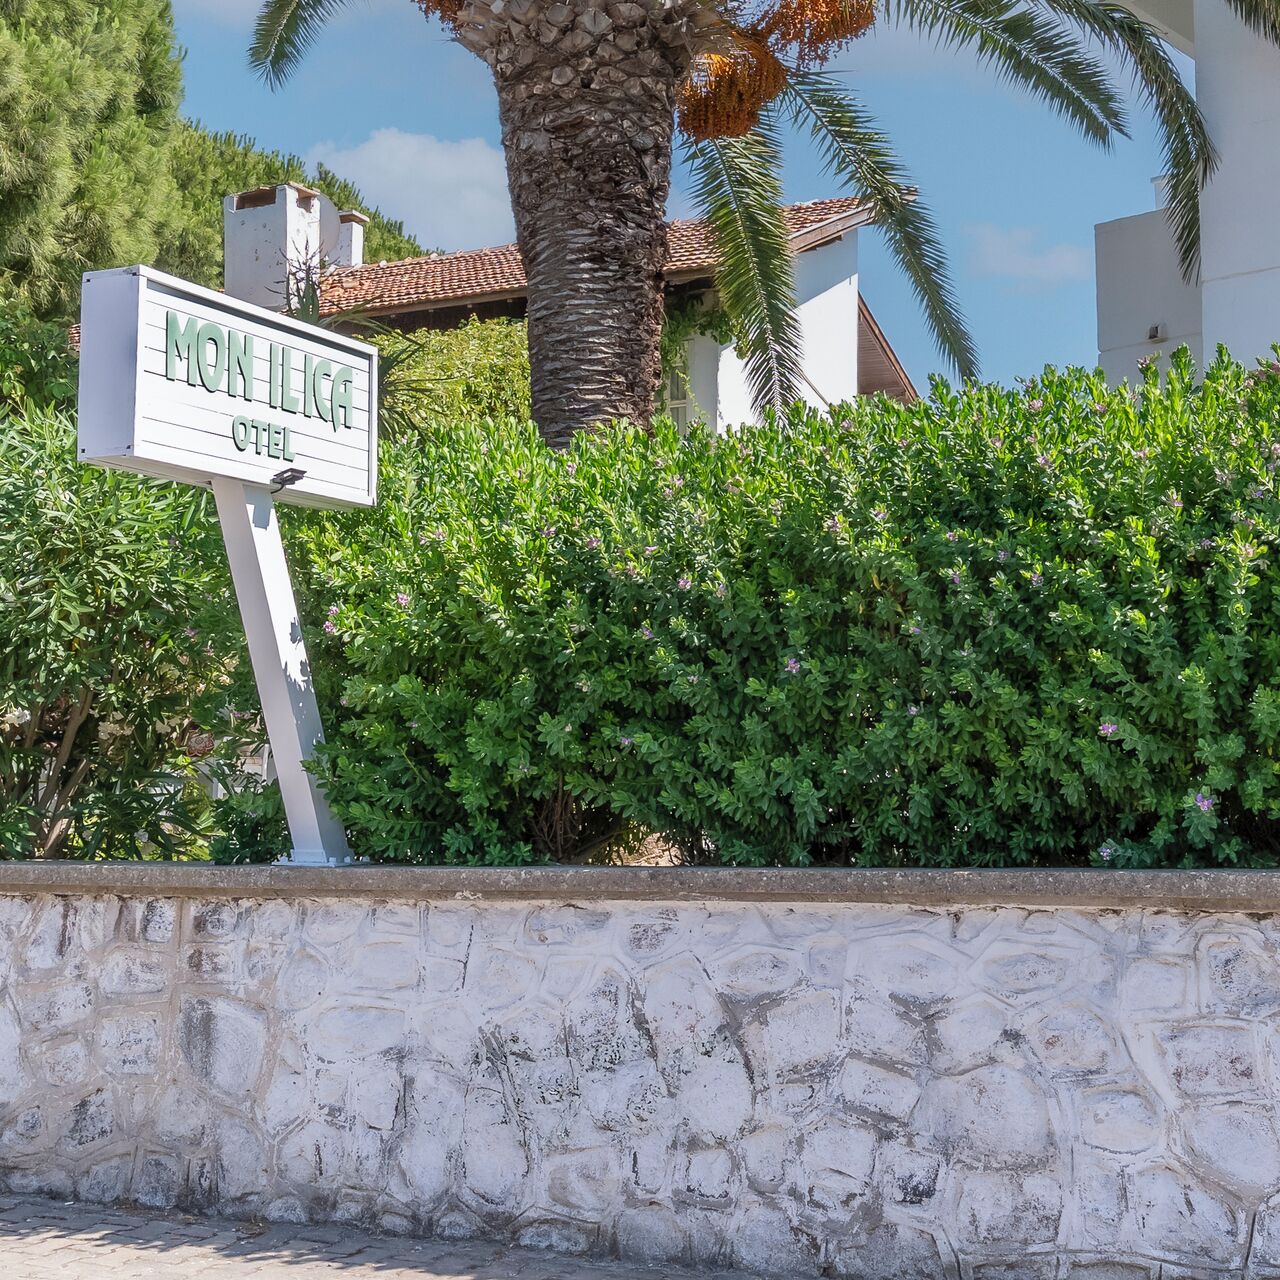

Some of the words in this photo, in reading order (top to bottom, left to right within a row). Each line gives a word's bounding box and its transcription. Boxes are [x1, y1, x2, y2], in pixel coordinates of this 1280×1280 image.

[166, 310, 254, 402] MON
[269, 342, 353, 432] ILICA
[232, 415, 296, 462] OTEL
